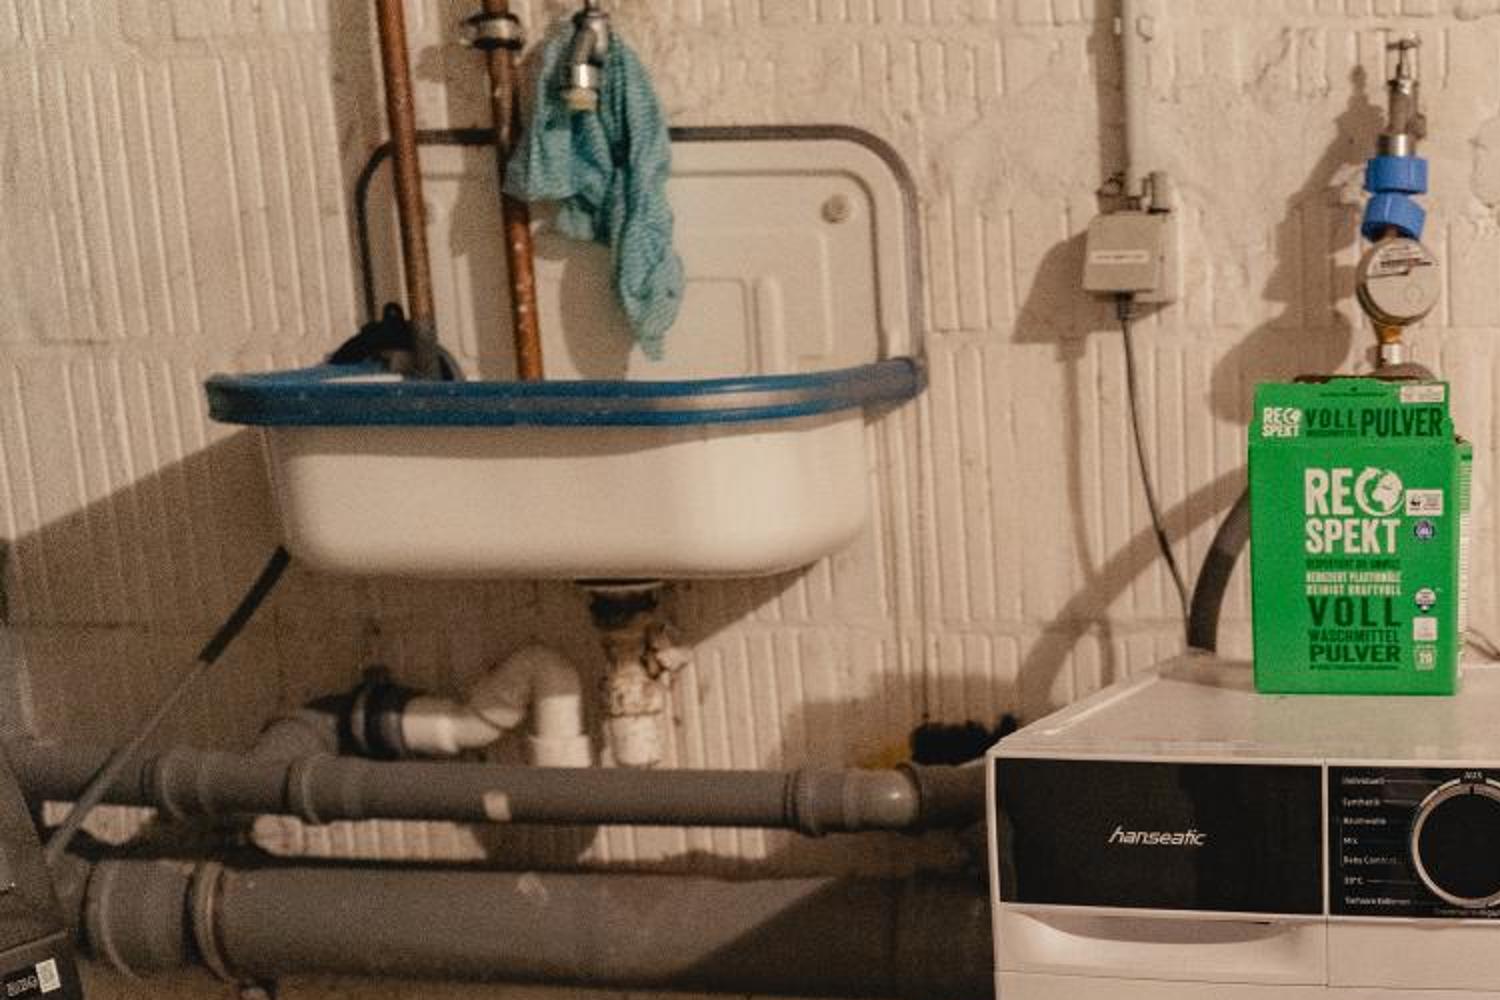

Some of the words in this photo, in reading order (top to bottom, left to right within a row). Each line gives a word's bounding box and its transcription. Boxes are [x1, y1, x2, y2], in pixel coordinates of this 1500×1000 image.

[1305, 408, 1357, 428] VOLL
[1360, 408, 1443, 438] PULVER
[1304, 518, 1401, 554] SPEKT
[1307, 596, 1402, 627] VOLL
[1308, 629, 1400, 643] WASCHMITTEL
[1309, 644, 1401, 663] PULVER
[1108, 825, 1206, 847] hanseatic
